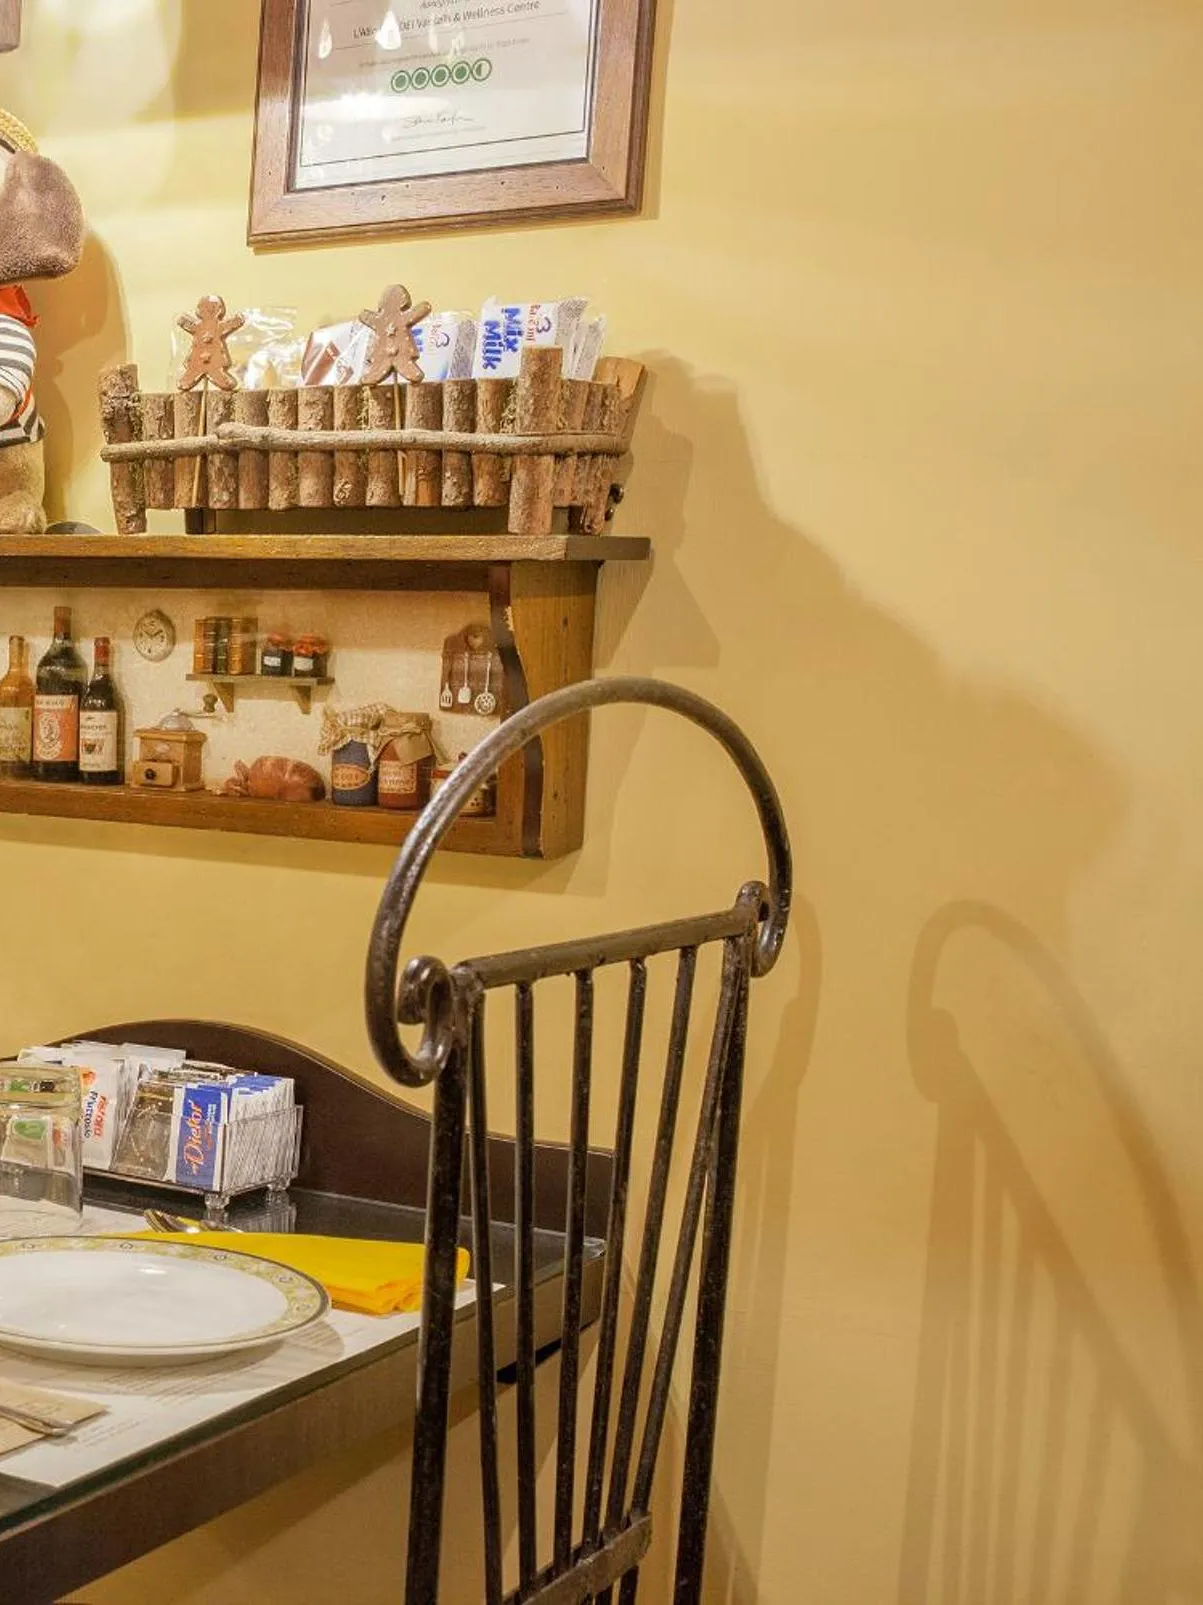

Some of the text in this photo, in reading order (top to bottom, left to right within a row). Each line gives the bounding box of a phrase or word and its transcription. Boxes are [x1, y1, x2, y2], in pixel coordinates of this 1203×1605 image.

[463, 7, 505, 20] Wellness
[506, 1, 539, 13] Centre
[482, 320, 502, 370] Milk
[502, 307, 523, 353] Mix
[183, 1099, 204, 1168] Dietor
